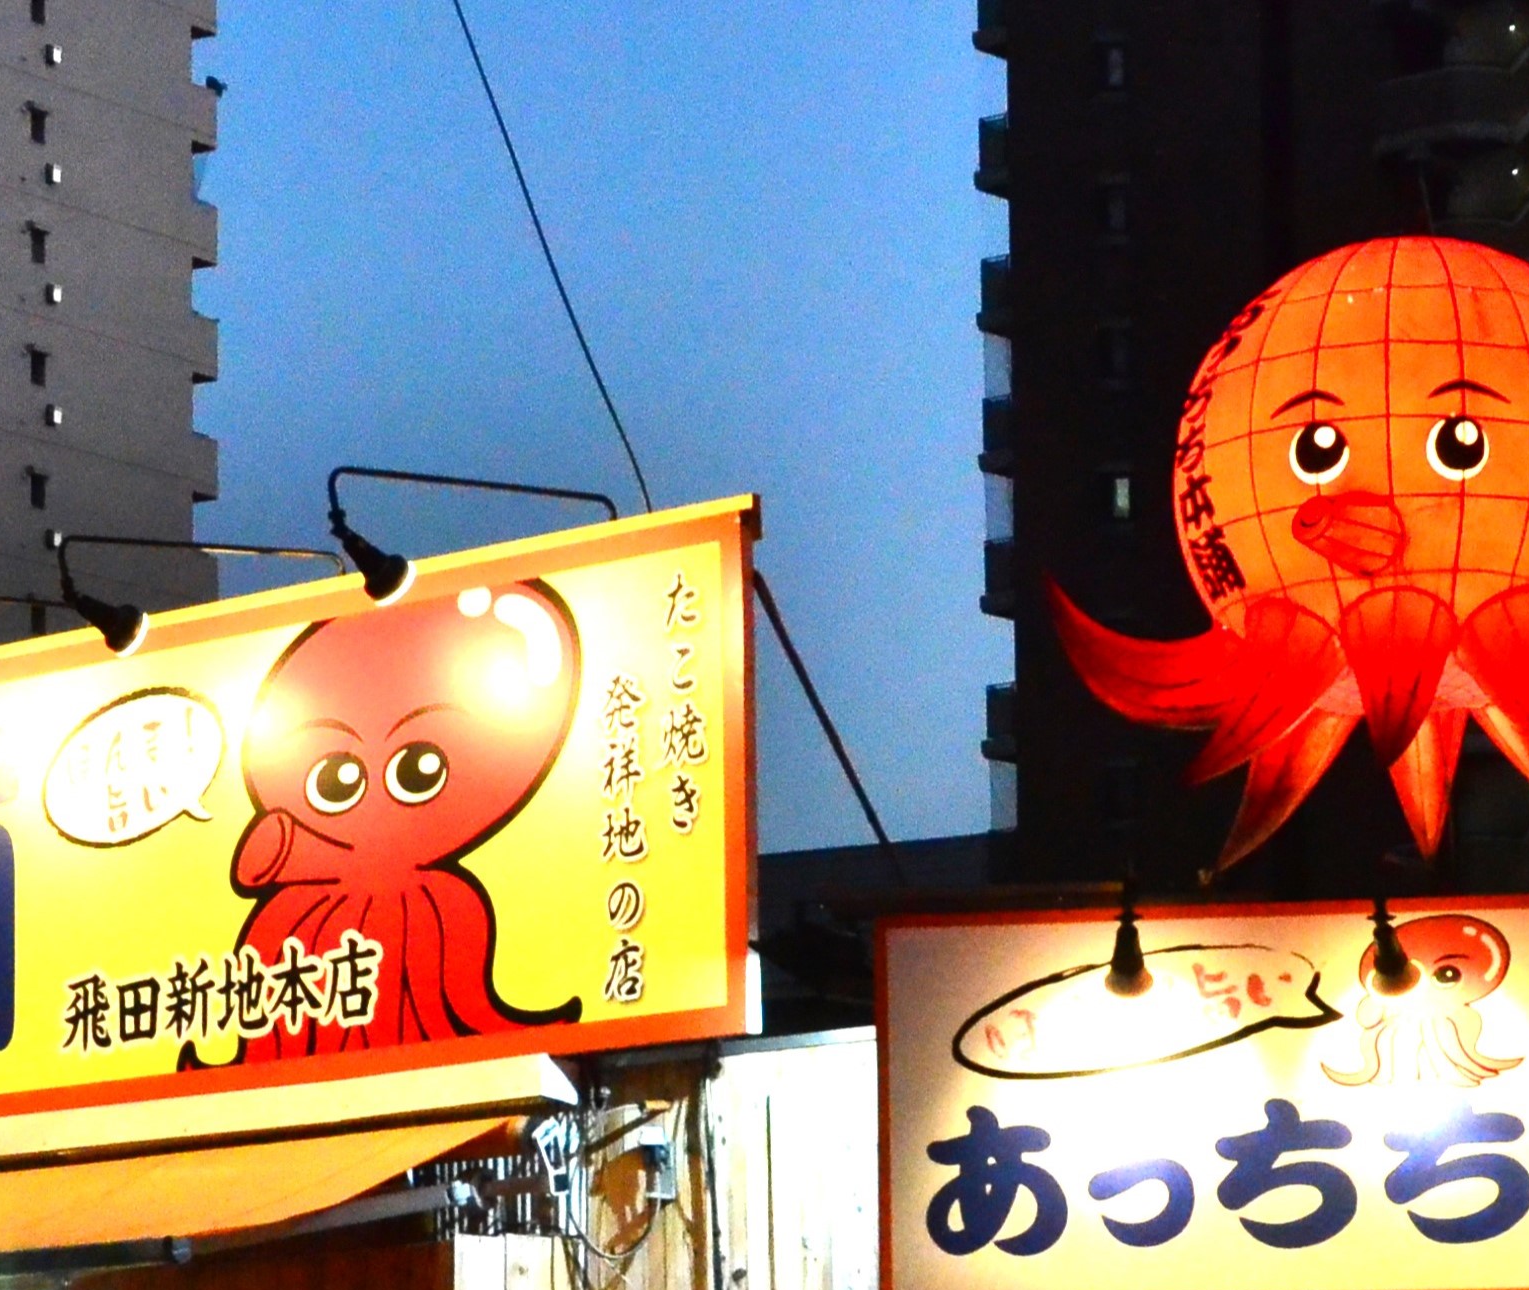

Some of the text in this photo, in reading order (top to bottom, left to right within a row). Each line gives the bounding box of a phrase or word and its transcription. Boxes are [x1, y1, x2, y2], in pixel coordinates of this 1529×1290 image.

[663, 574, 707, 829] たこ焼き
[603, 676, 645, 1002] 発祥地の店
[64, 940, 377, 1051] 飛田新地本店
